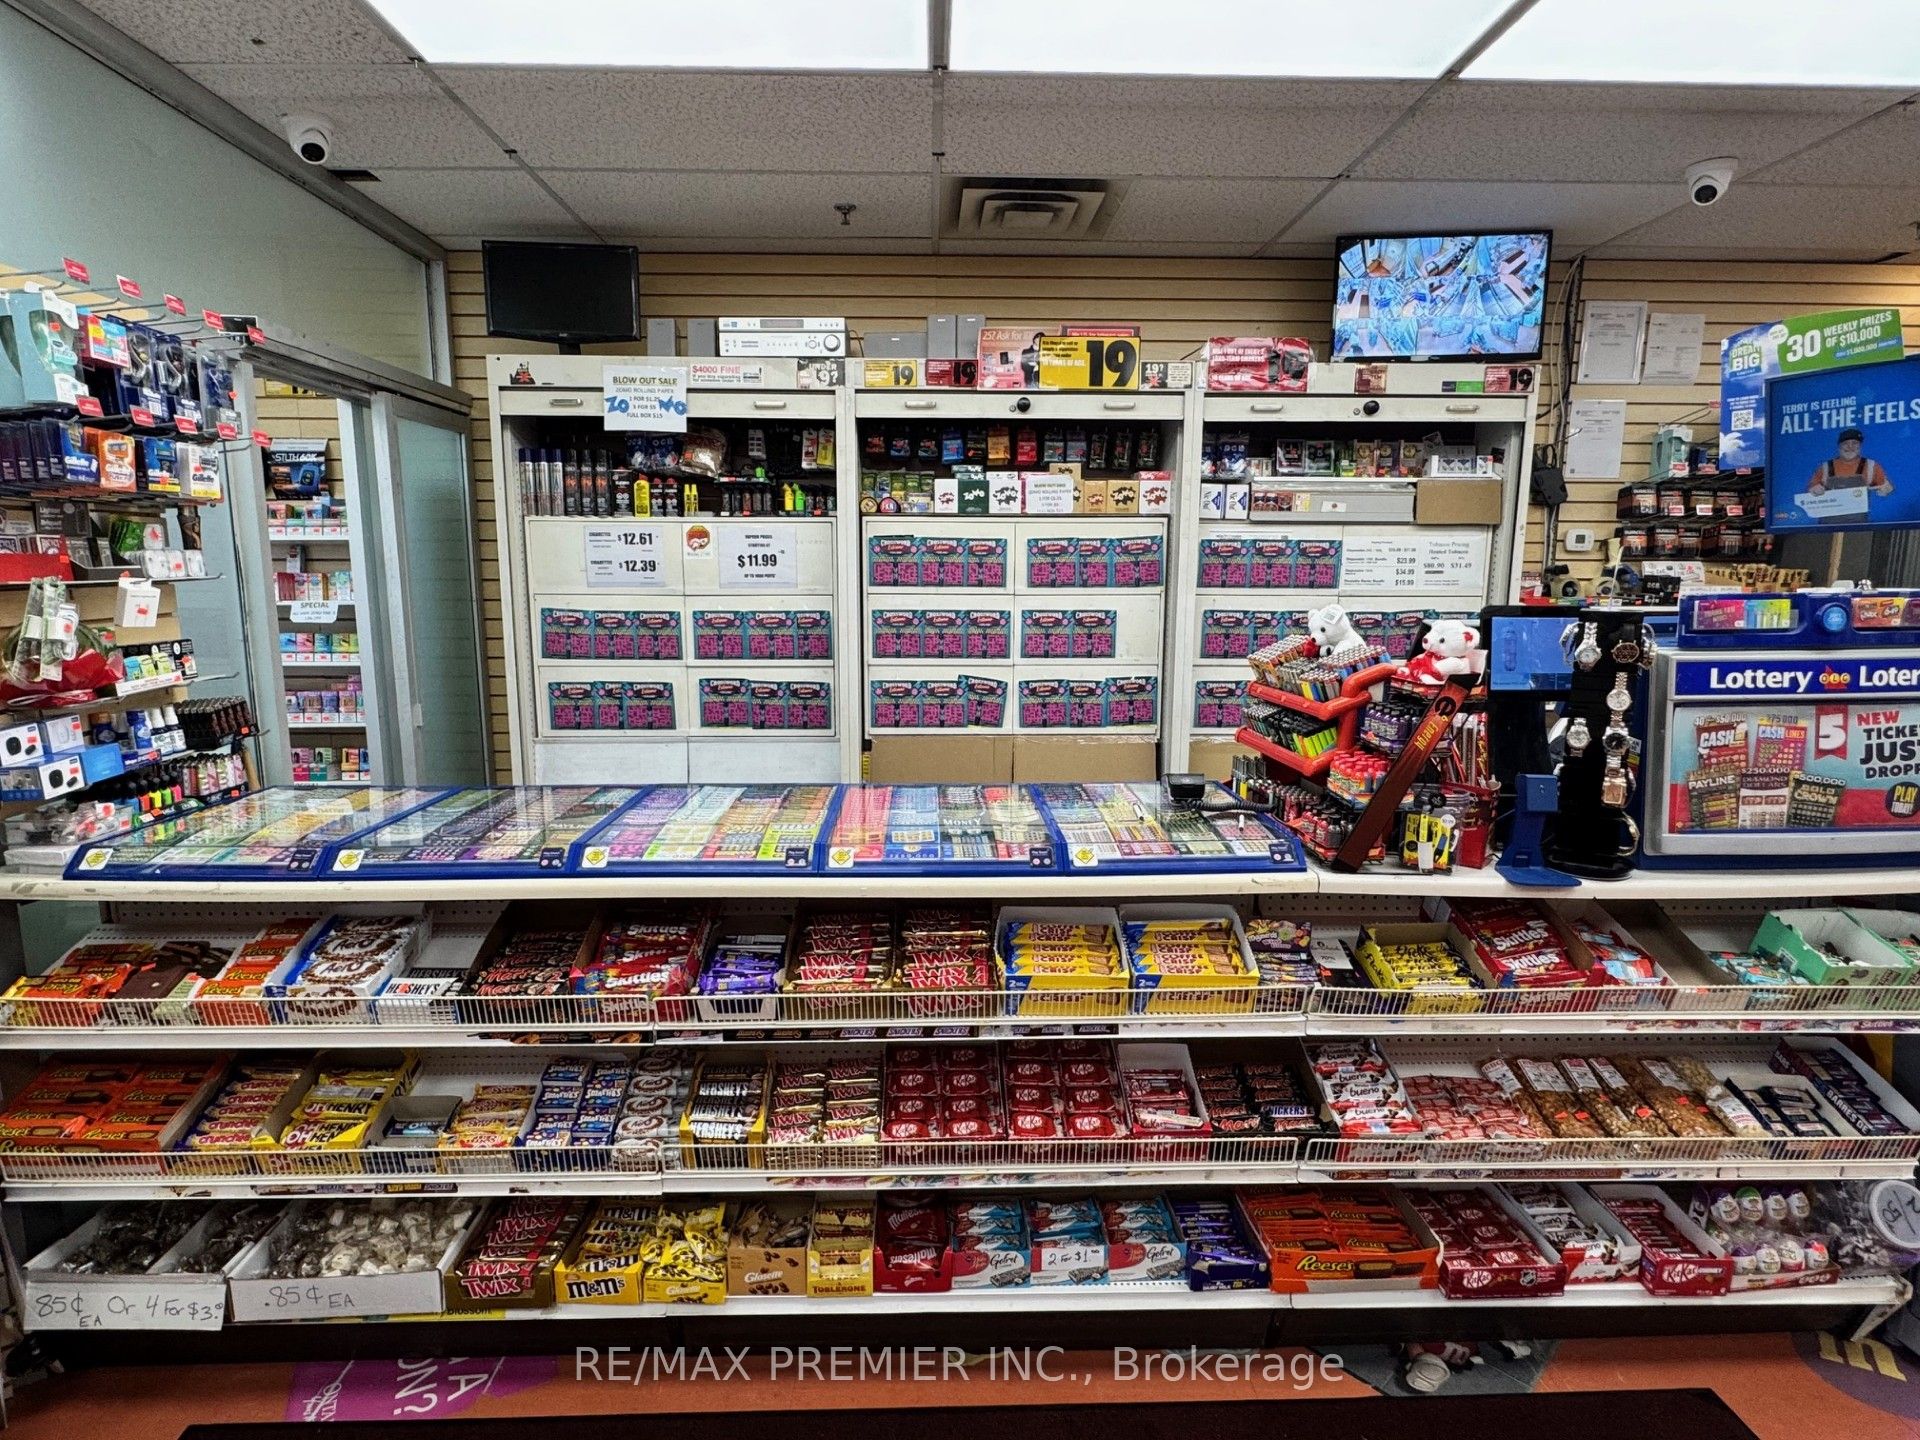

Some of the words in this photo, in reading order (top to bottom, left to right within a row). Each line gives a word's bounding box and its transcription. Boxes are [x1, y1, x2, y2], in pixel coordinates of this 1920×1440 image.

[1824, 319, 1858, 338] WEEKLY
[1860, 311, 1893, 328] PRIZES
[1826, 336, 1838, 348] OF
[1840, 325, 1881, 348] $10,000
[1786, 330, 1821, 362] 30
[720, 366, 741, 374] FINE
[1086, 340, 1136, 386] 19
[1145, 364, 1164, 372] 19?
[1732, 354, 1760, 372] BIG
[612, 376, 637, 384] BLOW
[892, 365, 914, 385] 19
[953, 362, 976, 386] 19
[1508, 370, 1534, 391] 19
[1782, 403, 1808, 414] TERRY
[1811, 401, 1820, 411] IS
[1822, 396, 1857, 409] FEELING
[64, 456, 90, 466] Gillette
[192, 473, 216, 483] Gillette
[737, 554, 778, 568] $11.99
[1710, 667, 1813, 692] Lottery
[1818, 672, 1850, 684] OLG
[1857, 710, 1900, 726] NEW
[1701, 730, 1734, 748] CASH
[1759, 726, 1784, 738] CASH
[1818, 713, 1846, 750] 5
[1688, 775, 1735, 790] PAYLINE
[1794, 792, 1838, 804] CROWN
[1895, 786, 1918, 802] PLAY
[627, 924, 688, 936] Skittles
[1494, 926, 1549, 950] Skittles
[1364, 952, 1386, 984] Flake
[1502, 952, 1560, 970] Skittles
[604, 971, 670, 989] Skittles
[1338, 1073, 1367, 1083] bueno
[1349, 1086, 1380, 1098] bueno
[326, 1102, 374, 1115] HENRY
[200, 1134, 251, 1145] crunchie
[990, 1252, 1018, 1267] Gofret
[1048, 1252, 1057, 1266] 2
[1146, 1246, 1174, 1262] Gofret
[744, 1270, 784, 1284] Glosette
[1463, 1269, 1493, 1289] KitKat
[1665, 1264, 1698, 1284] KitKat
[566, 1276, 625, 1300] m&m's
[812, 1285, 867, 1294] TOBLERONE
[36, 1292, 84, 1318] 85¢
[108, 1296, 136, 1315] Or
[146, 1294, 160, 1318] 4
[164, 1299, 184, 1316] For
[329, 1293, 356, 1310] EA
[79, 1314, 103, 1328] EA
